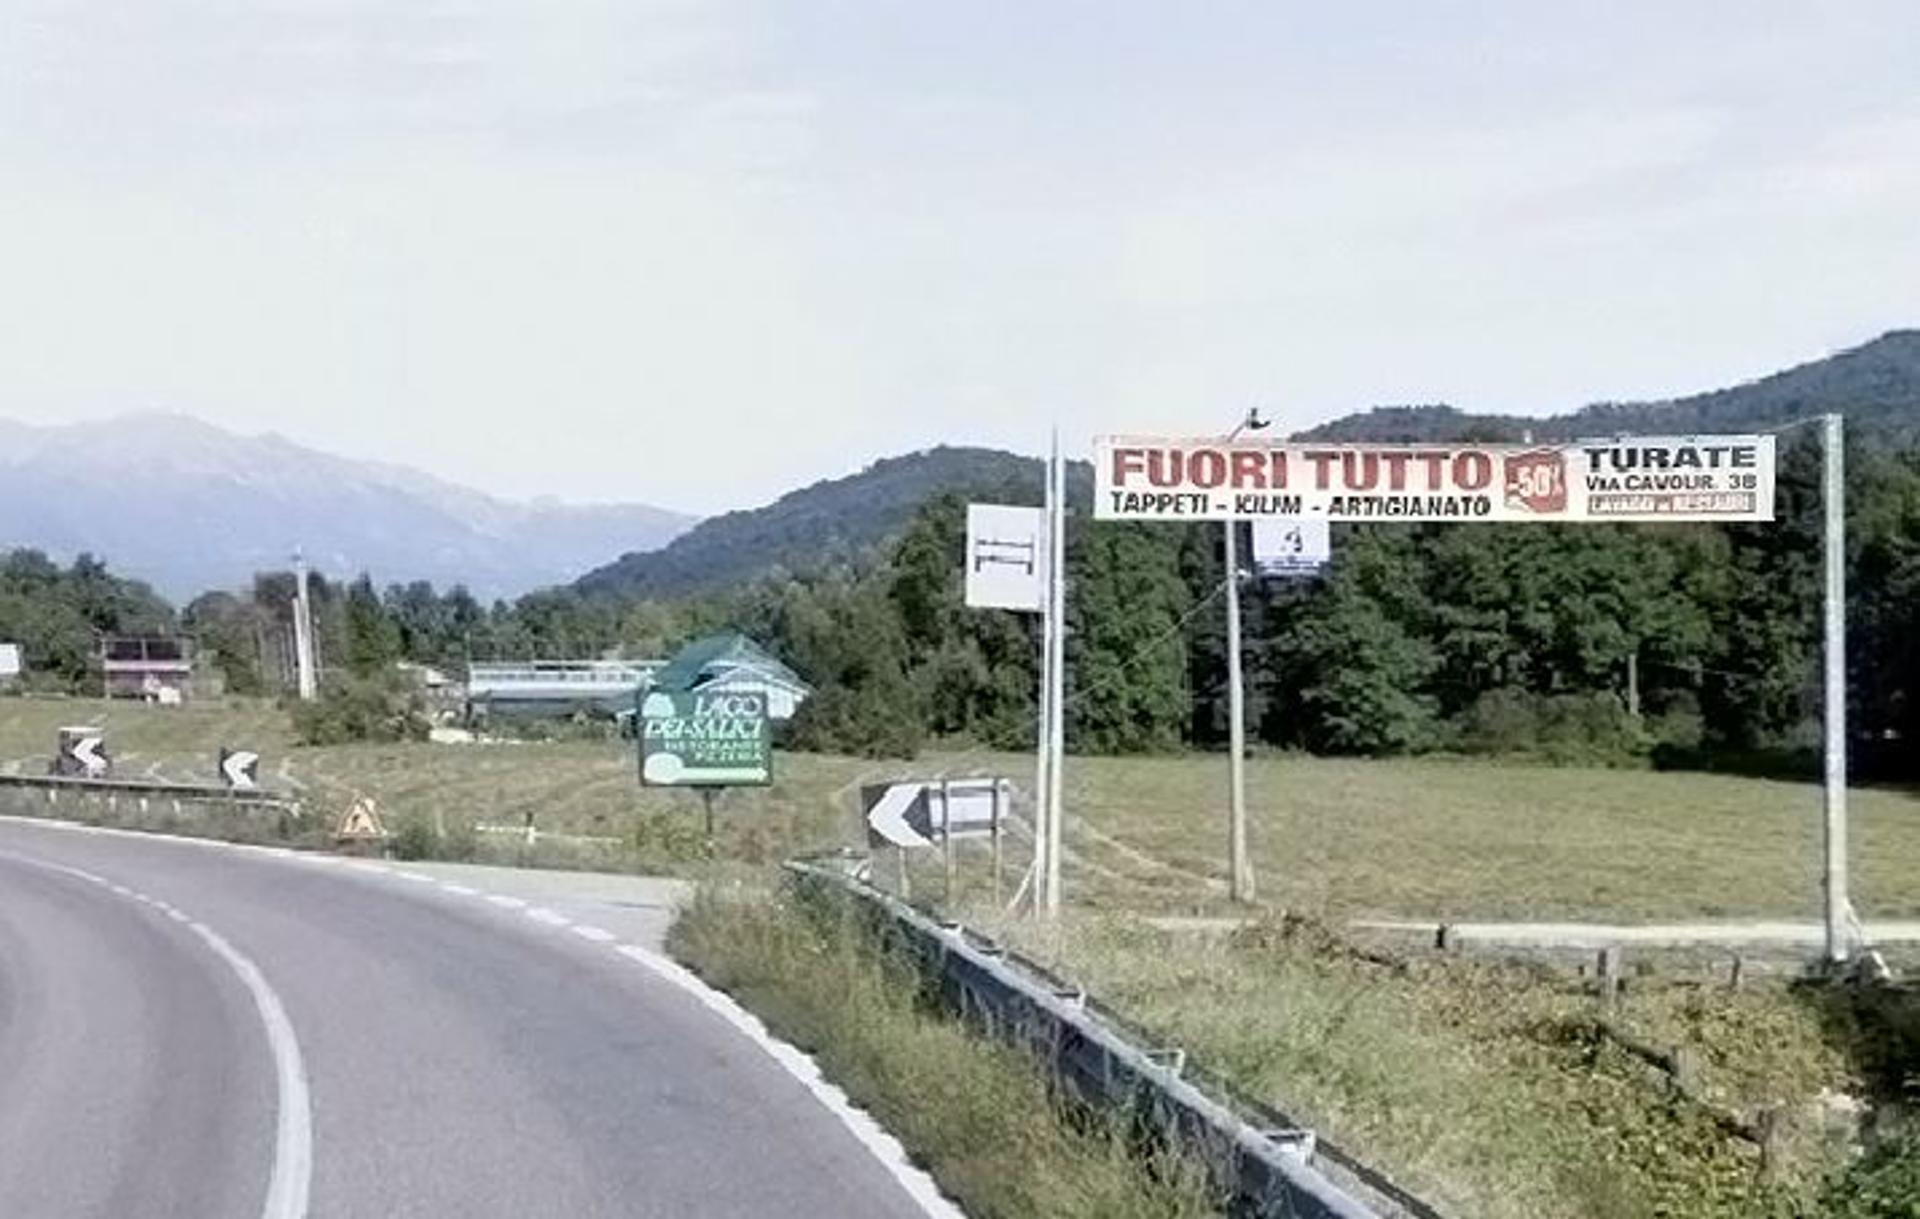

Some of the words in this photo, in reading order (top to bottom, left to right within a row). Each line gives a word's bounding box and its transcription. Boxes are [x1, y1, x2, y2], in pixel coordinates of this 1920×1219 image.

[1112, 449, 1288, 489] FUORI
[1303, 450, 1492, 491] TUTTO
[1583, 446, 1757, 470] TURATE
[1586, 475, 1620, 491] VIA
[1110, 491, 1209, 514] TAPPETI
[1234, 494, 1302, 514] KILIM
[1328, 495, 1492, 516] ARTIGIANATO
[695, 696, 762, 717] LAGO
